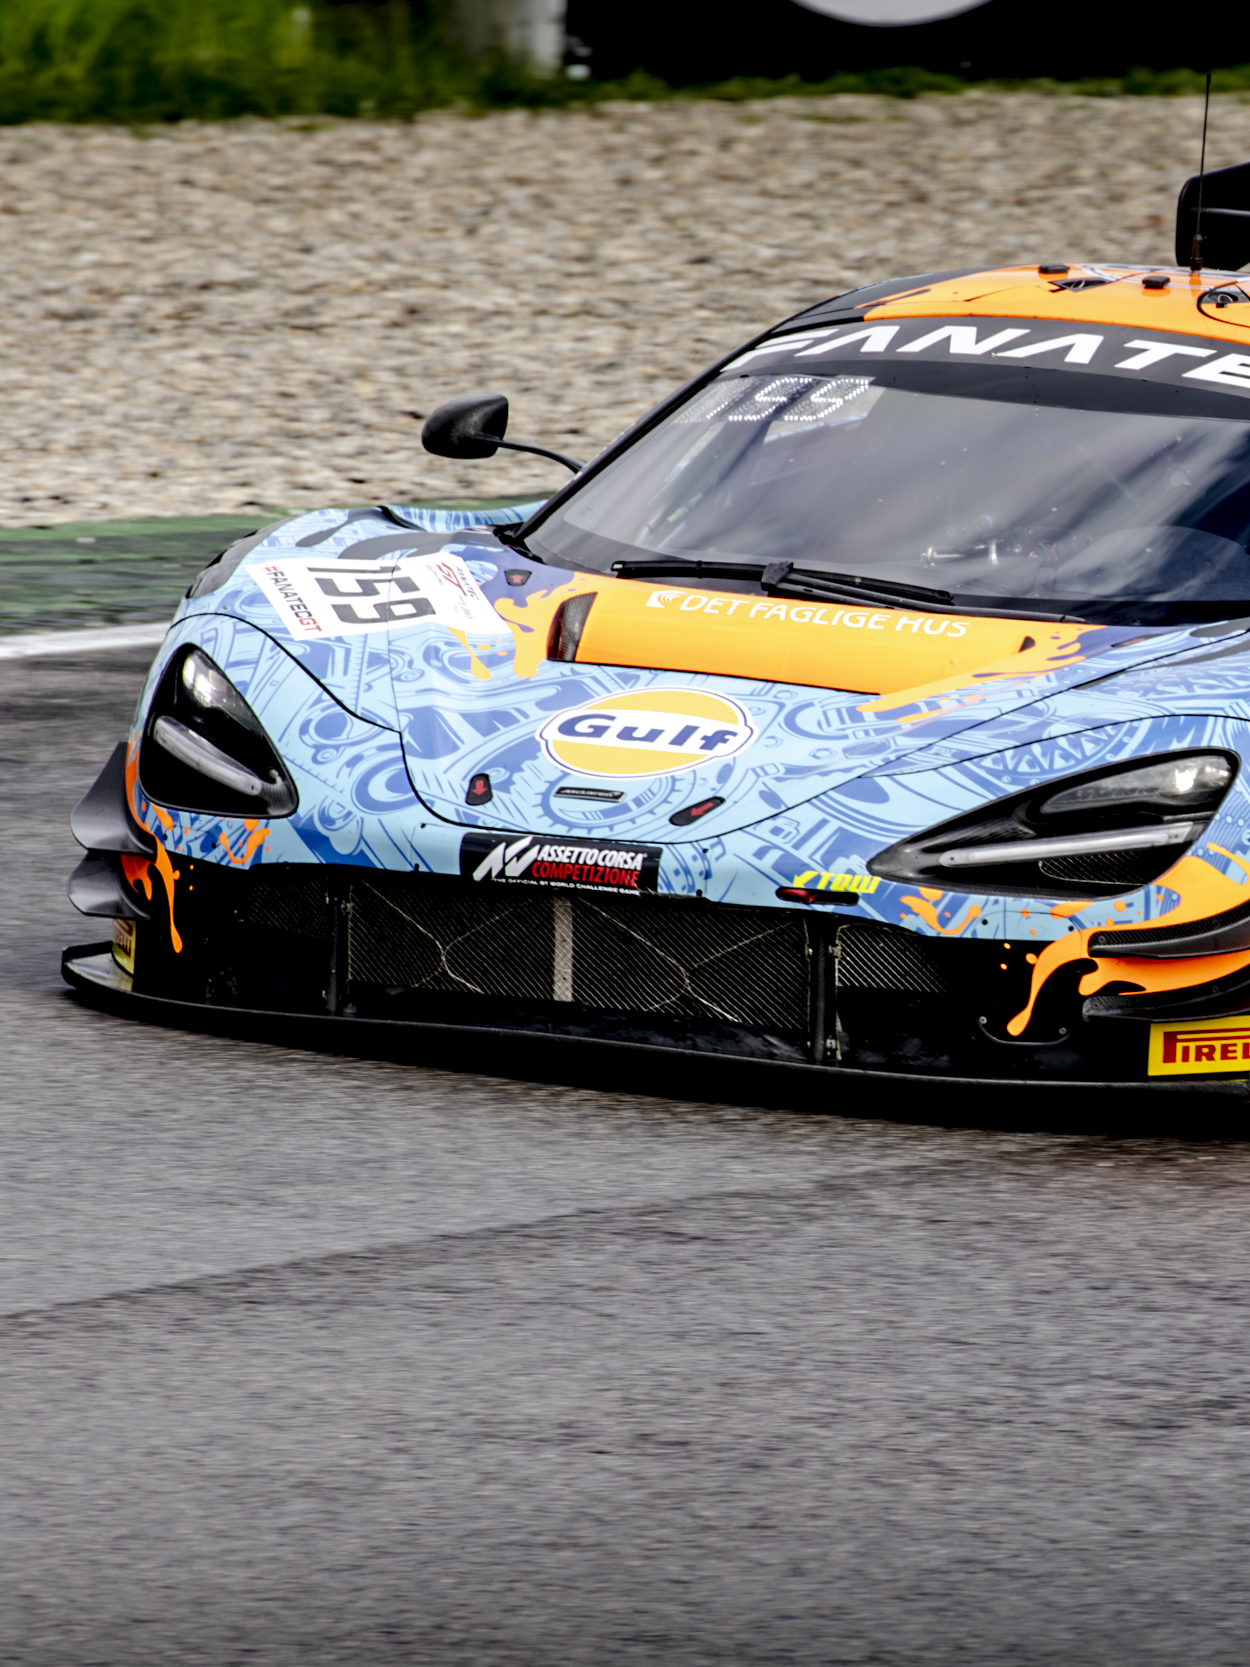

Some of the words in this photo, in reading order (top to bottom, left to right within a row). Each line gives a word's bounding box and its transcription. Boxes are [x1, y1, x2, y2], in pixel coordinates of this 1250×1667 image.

[262, 565, 322, 632] #FANATECGT
[306, 565, 436, 625] 159
[679, 593, 749, 617] DET
[749, 602, 891, 630] FAGLIGE
[895, 616, 971, 638] HUS
[557, 713, 739, 751] Gulf
[532, 861, 641, 887] COMPETIZIONE
[537, 844, 599, 865] ASSETTO
[599, 849, 645, 871] CORSA
[817, 872, 882, 894] TOW
